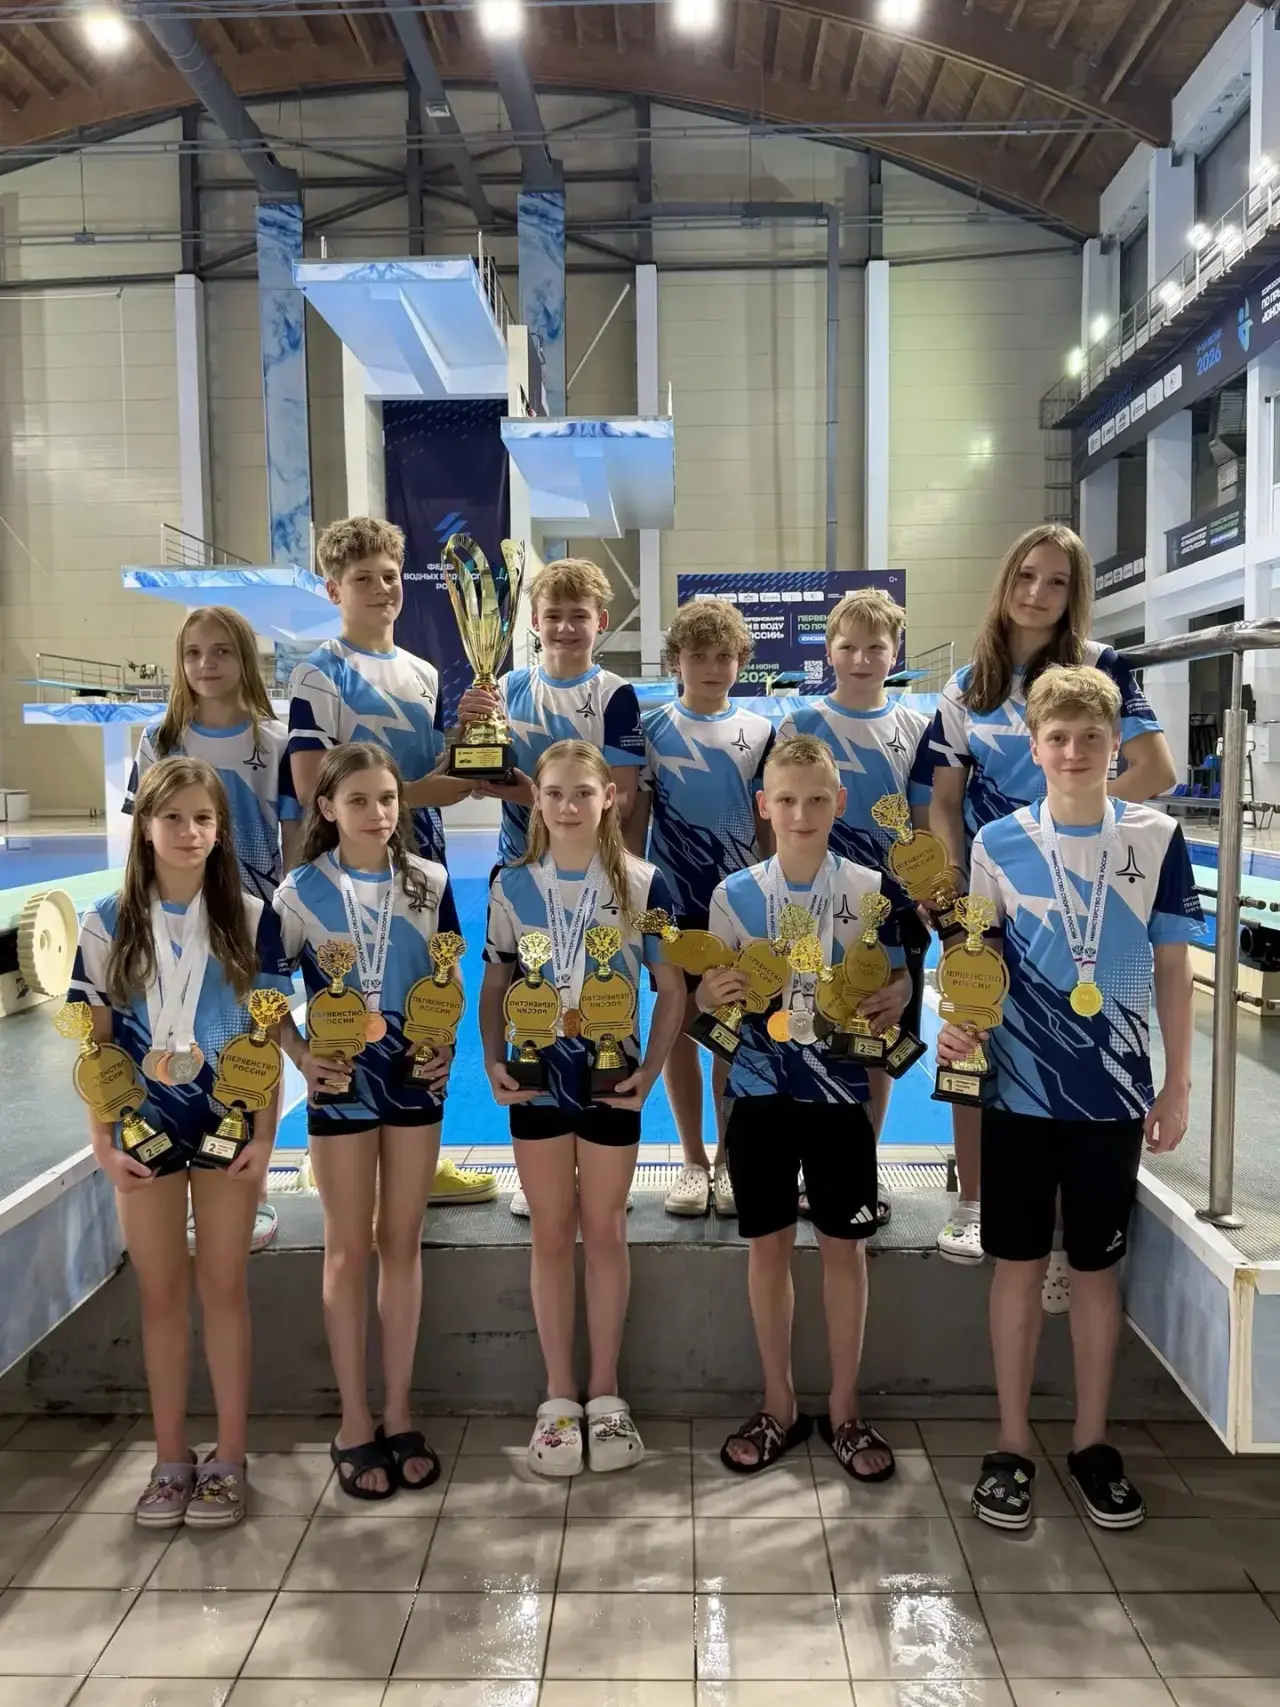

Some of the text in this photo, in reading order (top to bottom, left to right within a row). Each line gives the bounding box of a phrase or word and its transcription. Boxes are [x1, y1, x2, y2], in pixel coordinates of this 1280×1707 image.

[1196, 346, 1222, 377] 2026
[403, 572, 439, 580] ВОДНЫХ
[760, 622, 785, 631] ВОДУ
[797, 623, 811, 631] ПО
[738, 671, 779, 684] 2026
[896, 848, 935, 870] ПЕРВЕНСТВ
[748, 955, 784, 984] ЕРВЕНСТВО
[412, 996, 461, 1009] ПЕРВЕНСТВО
[312, 1010, 363, 1018] ВЕНСТВО
[419, 1005, 452, 1016] РОССИИ
[714, 1031, 723, 1041] 2
[860, 1043, 866, 1053] 2
[226, 1054, 278, 1071] ПЕРВЕНСТВО
[894, 1054, 903, 1063] 2
[232, 1063, 267, 1077] РОССИИ
[145, 1147, 154, 1158] 2
[208, 1143, 217, 1153] 2
